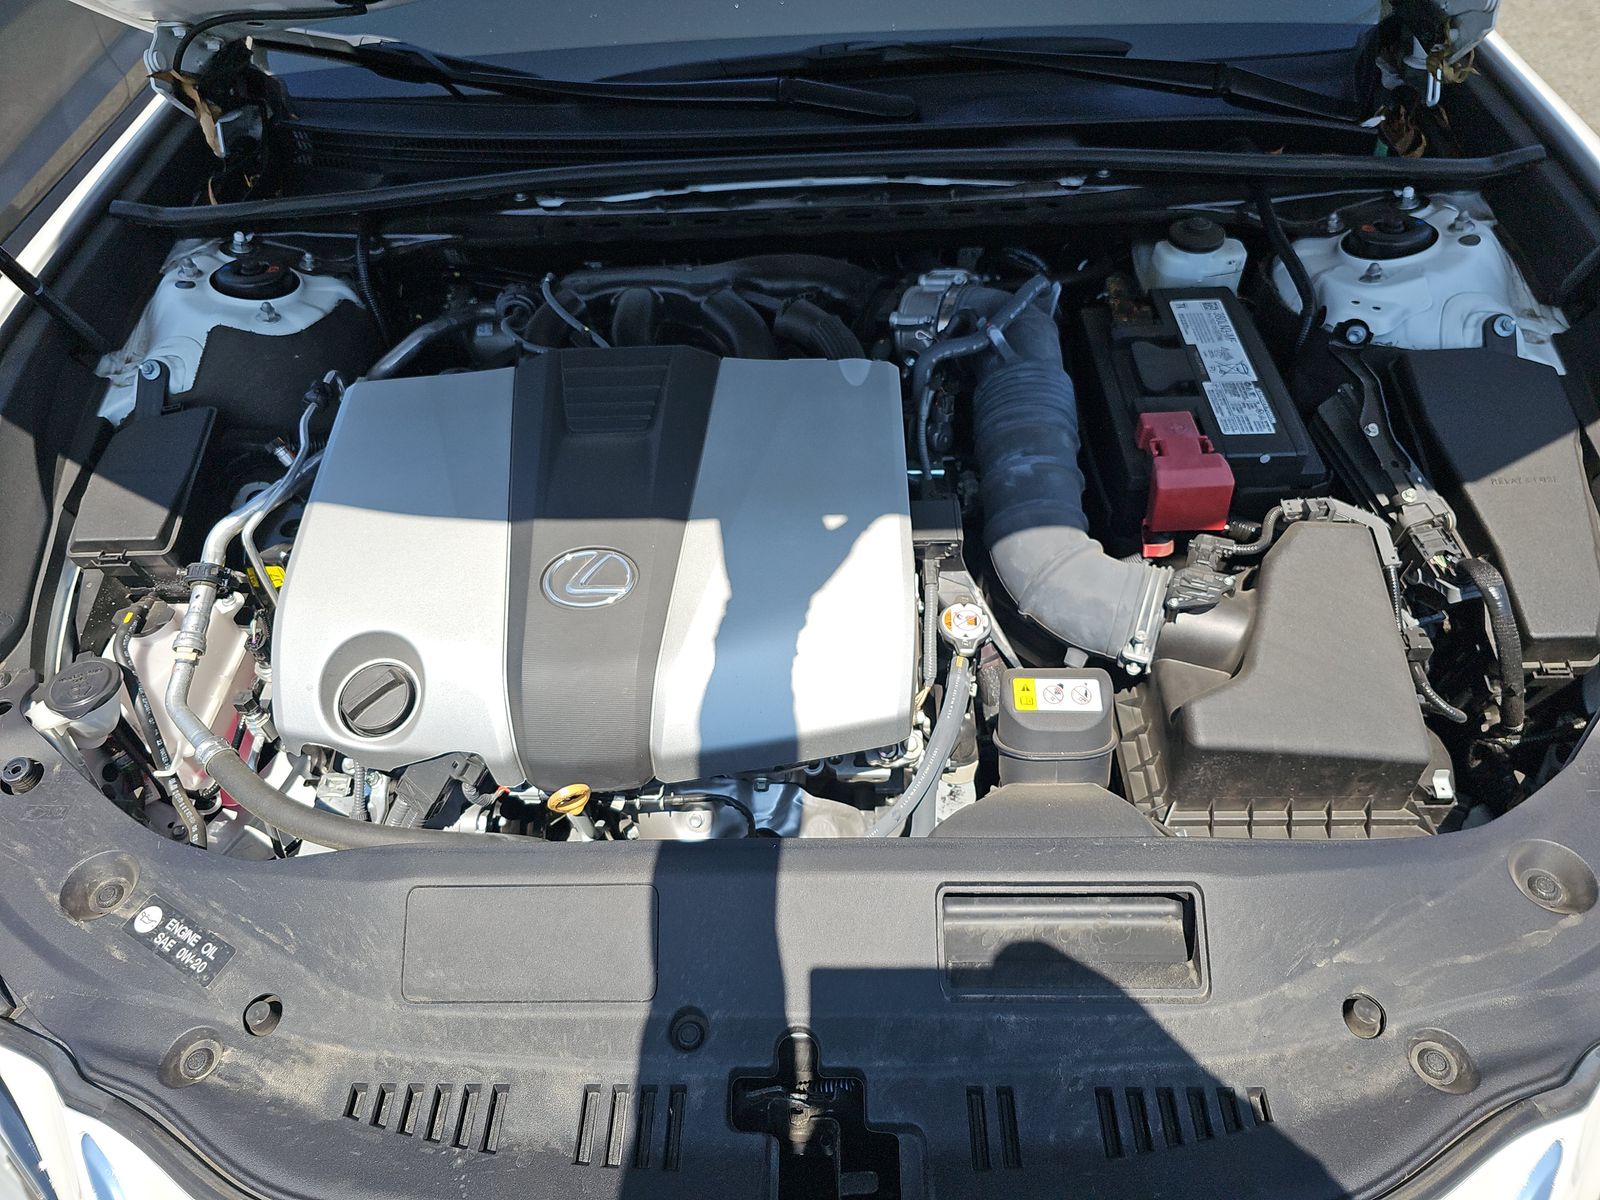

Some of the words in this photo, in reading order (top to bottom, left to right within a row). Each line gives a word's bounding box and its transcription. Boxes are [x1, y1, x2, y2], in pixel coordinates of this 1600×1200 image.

[153, 932, 177, 952] SAE
[176, 947, 208, 974] 0W-20
[165, 918, 202, 947] ENGINE
[201, 942, 219, 961] OIL
